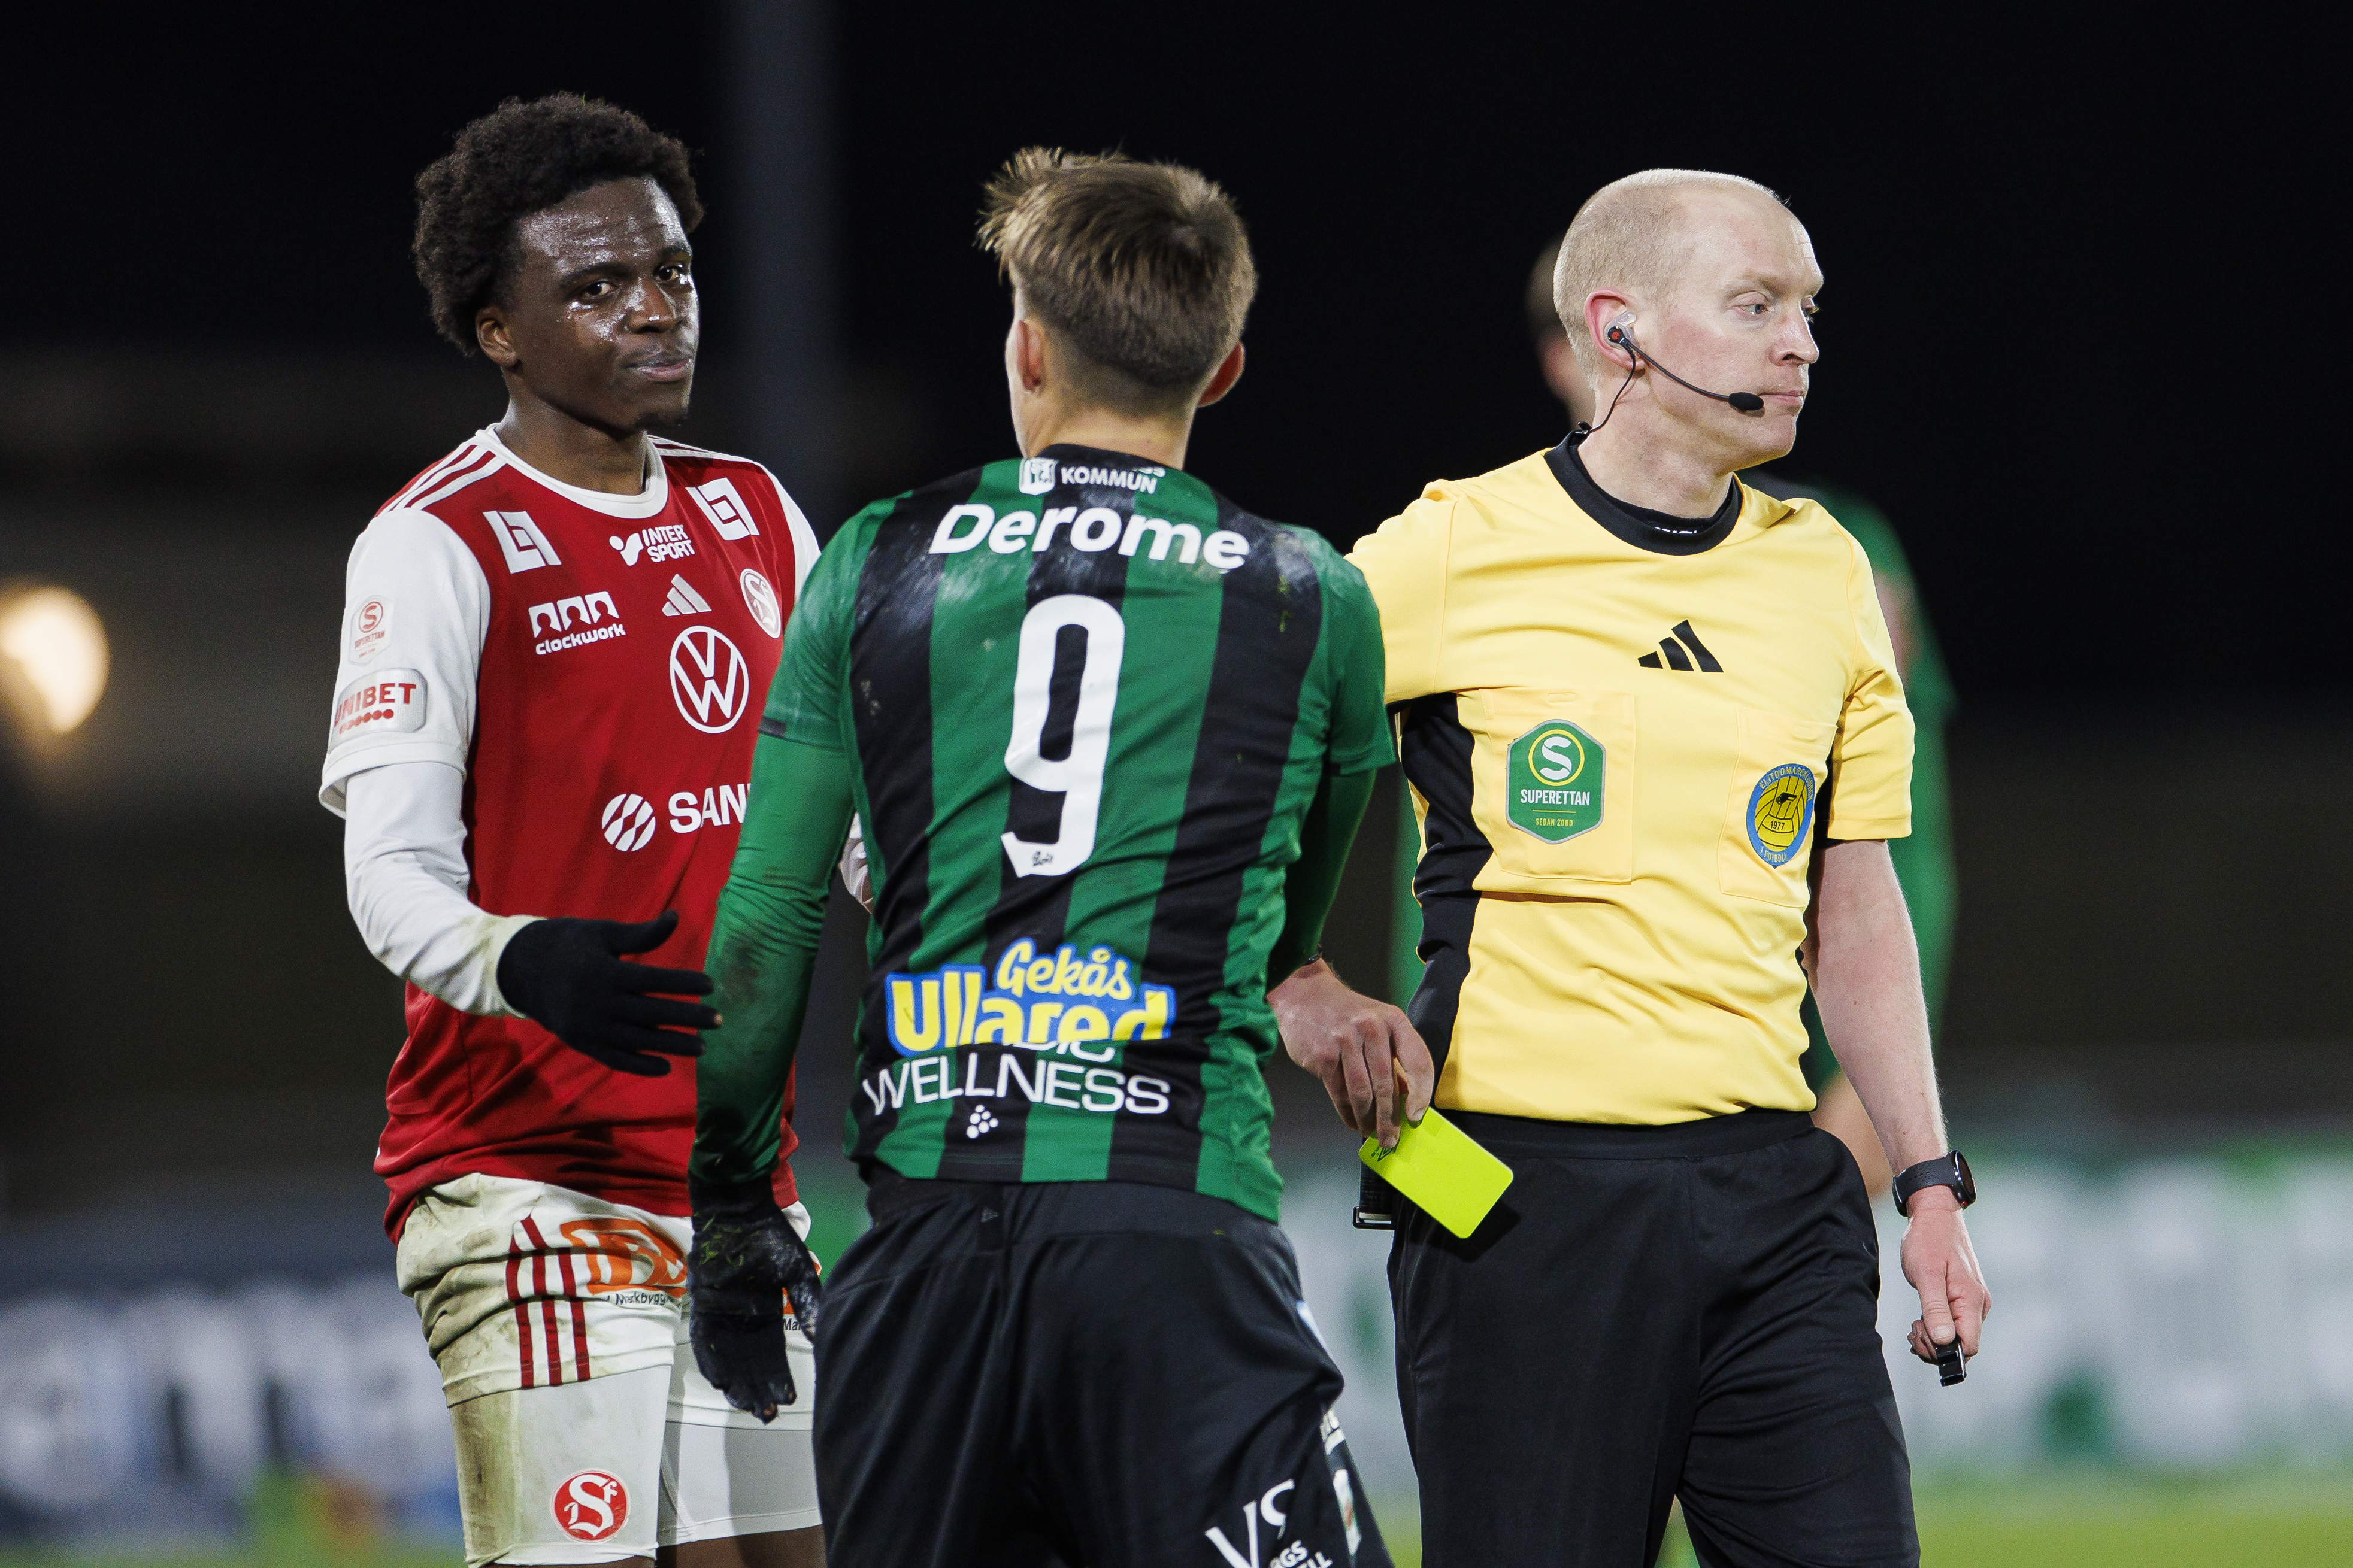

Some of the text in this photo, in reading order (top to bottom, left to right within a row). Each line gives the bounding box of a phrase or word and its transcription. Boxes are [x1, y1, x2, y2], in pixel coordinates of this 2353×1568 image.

[1061, 466, 1158, 495] KOMMUN
[642, 524, 688, 547] INTER
[647, 539, 695, 563] SPORT
[928, 504, 1250, 570] Derome
[535, 623, 626, 655] clockwork
[334, 683, 417, 727] UNIBET
[1001, 594, 1125, 878] 9
[1539, 736, 1573, 780] S
[668, 783, 751, 833] SAN
[1520, 788, 1591, 806] SUPERETTAN
[1535, 818, 1573, 827] SEDAN 2000
[1770, 820, 1785, 830] 1977
[997, 941, 1132, 1001] Gekås
[891, 970, 1169, 1052] Ullared
[862, 1052, 1171, 1116] WELLNESS
